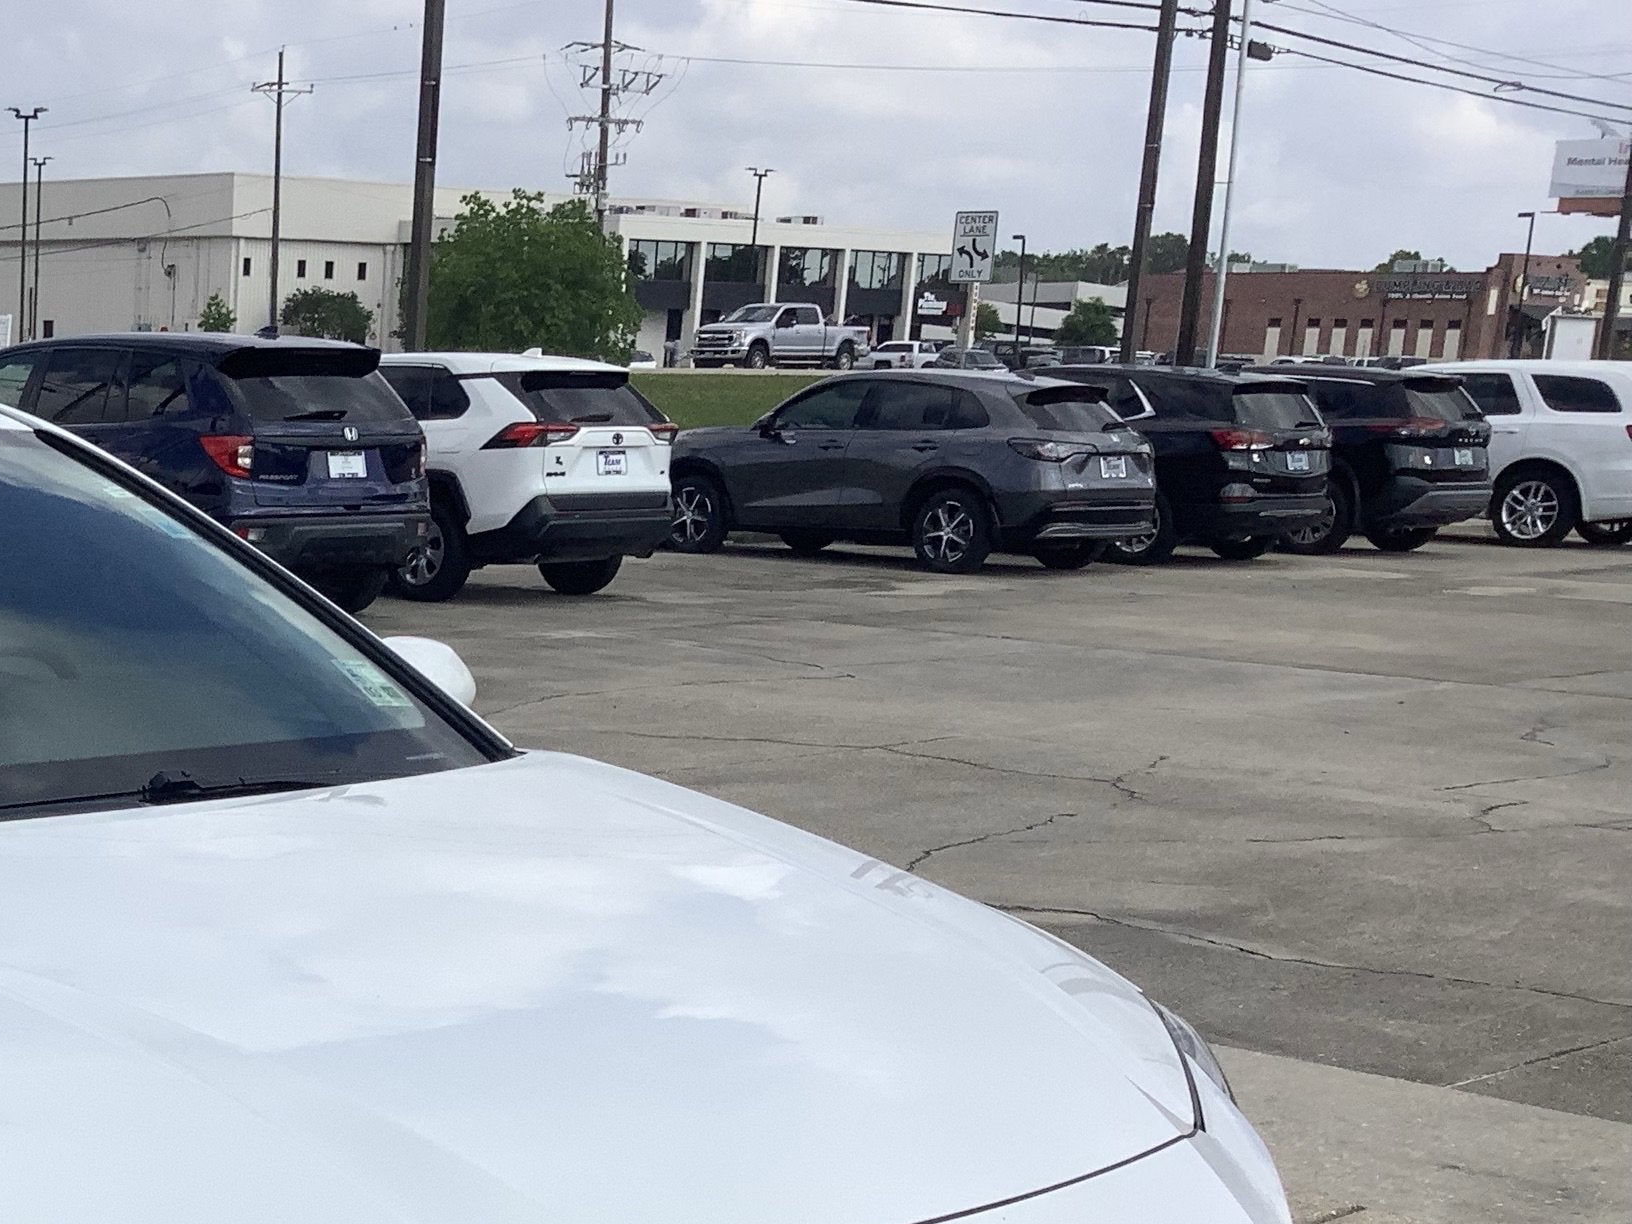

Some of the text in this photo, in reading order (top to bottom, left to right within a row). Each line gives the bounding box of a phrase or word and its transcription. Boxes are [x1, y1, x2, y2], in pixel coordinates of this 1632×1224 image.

[959, 215, 995, 224] CENTER
[963, 225, 988, 234] LANE
[958, 269, 983, 279] ONLY
